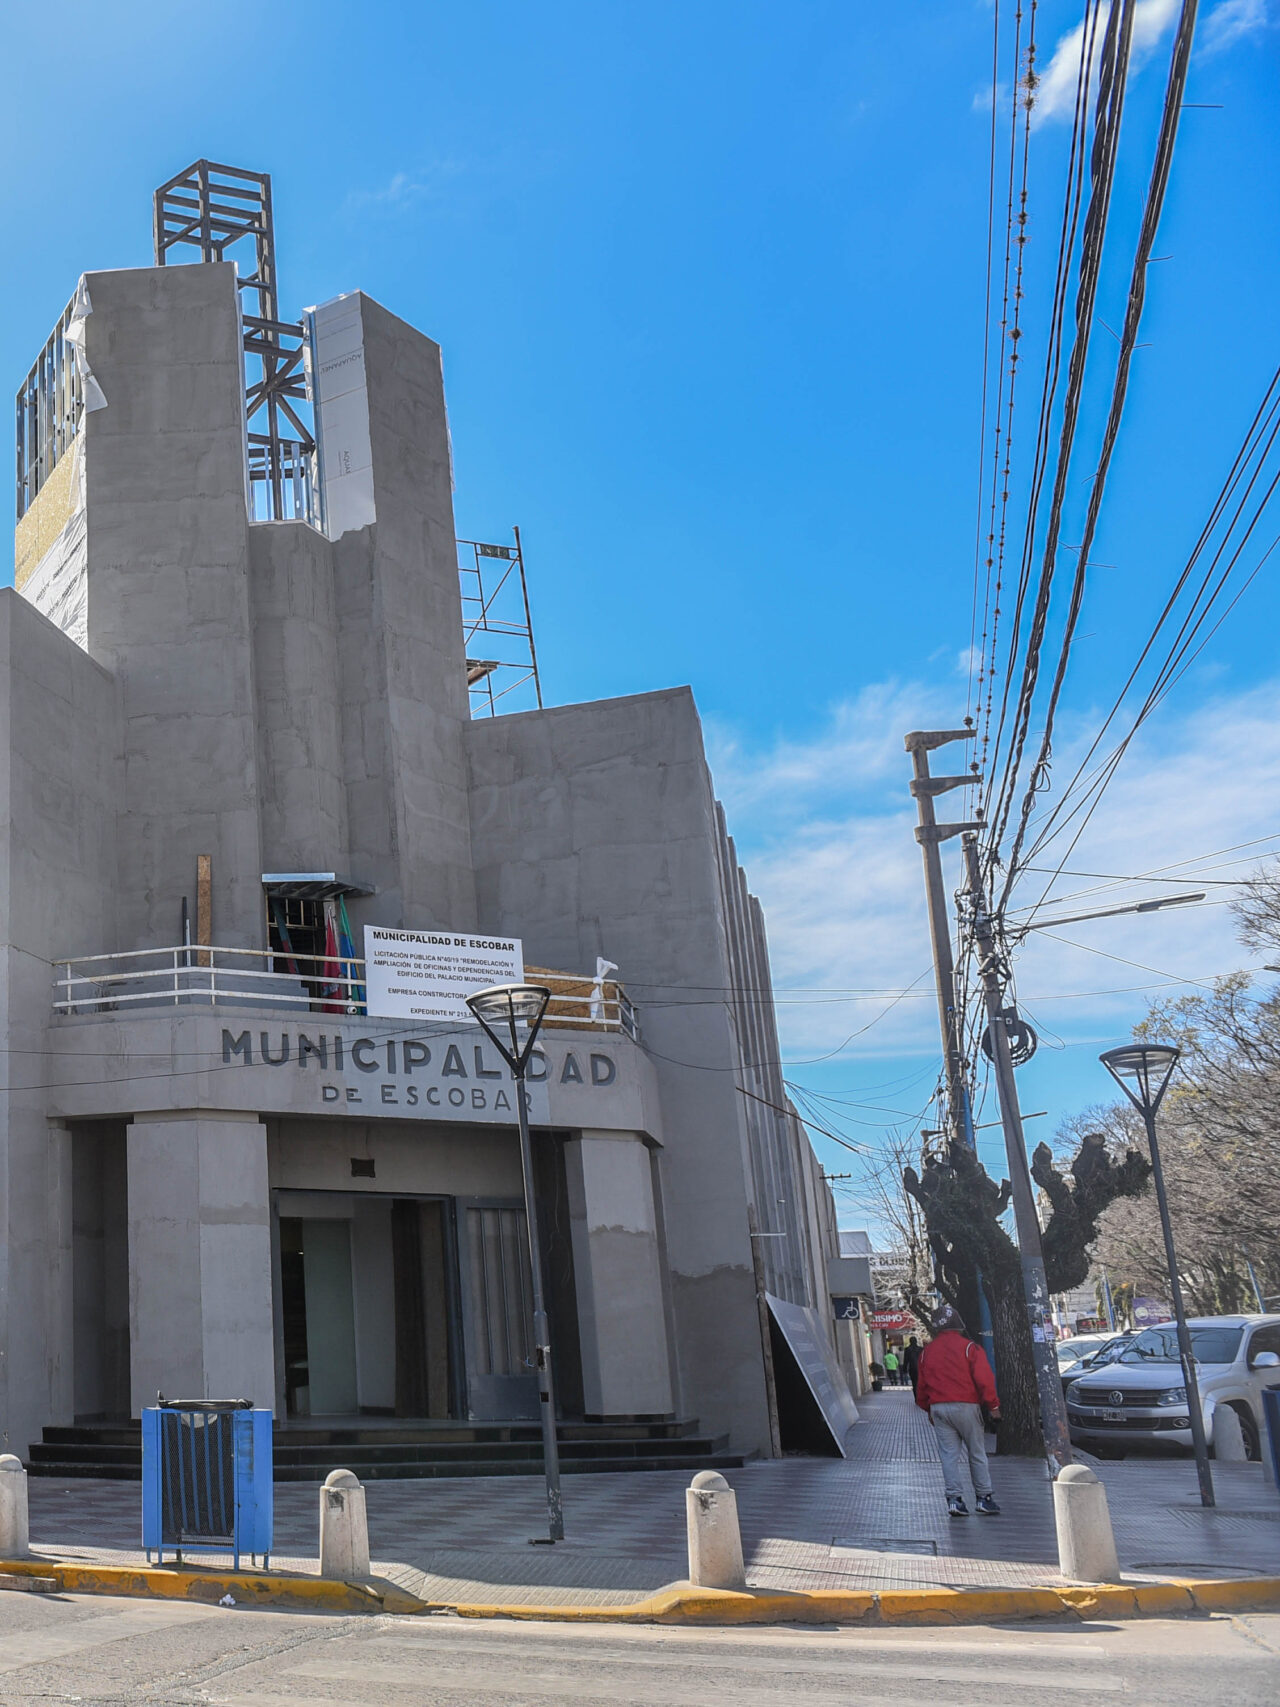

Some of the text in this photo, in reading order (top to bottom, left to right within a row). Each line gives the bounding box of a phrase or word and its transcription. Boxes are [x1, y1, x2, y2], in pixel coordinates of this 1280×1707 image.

[373, 931, 515, 951] MUNICIPALIDAD DE ESCOBAR
[374, 950, 409, 960] LICITACIÓN
[410, 952, 436, 961] PÚBLICA
[373, 959, 411, 968] AMPLIACIÓN
[414, 962, 422, 970] DE
[423, 963, 452, 972] OFICINAS
[457, 966, 504, 976] DEPENDENCIAS
[397, 970, 496, 984] EDIFICIO DEL PALACIO MUNICIPAL
[388, 987, 418, 996] EMPRESA
[410, 1007, 448, 1017] EXPEDIENTE
[222, 1028, 617, 1088] MUNICIPALDAD
[322, 1084, 363, 1105] DE
